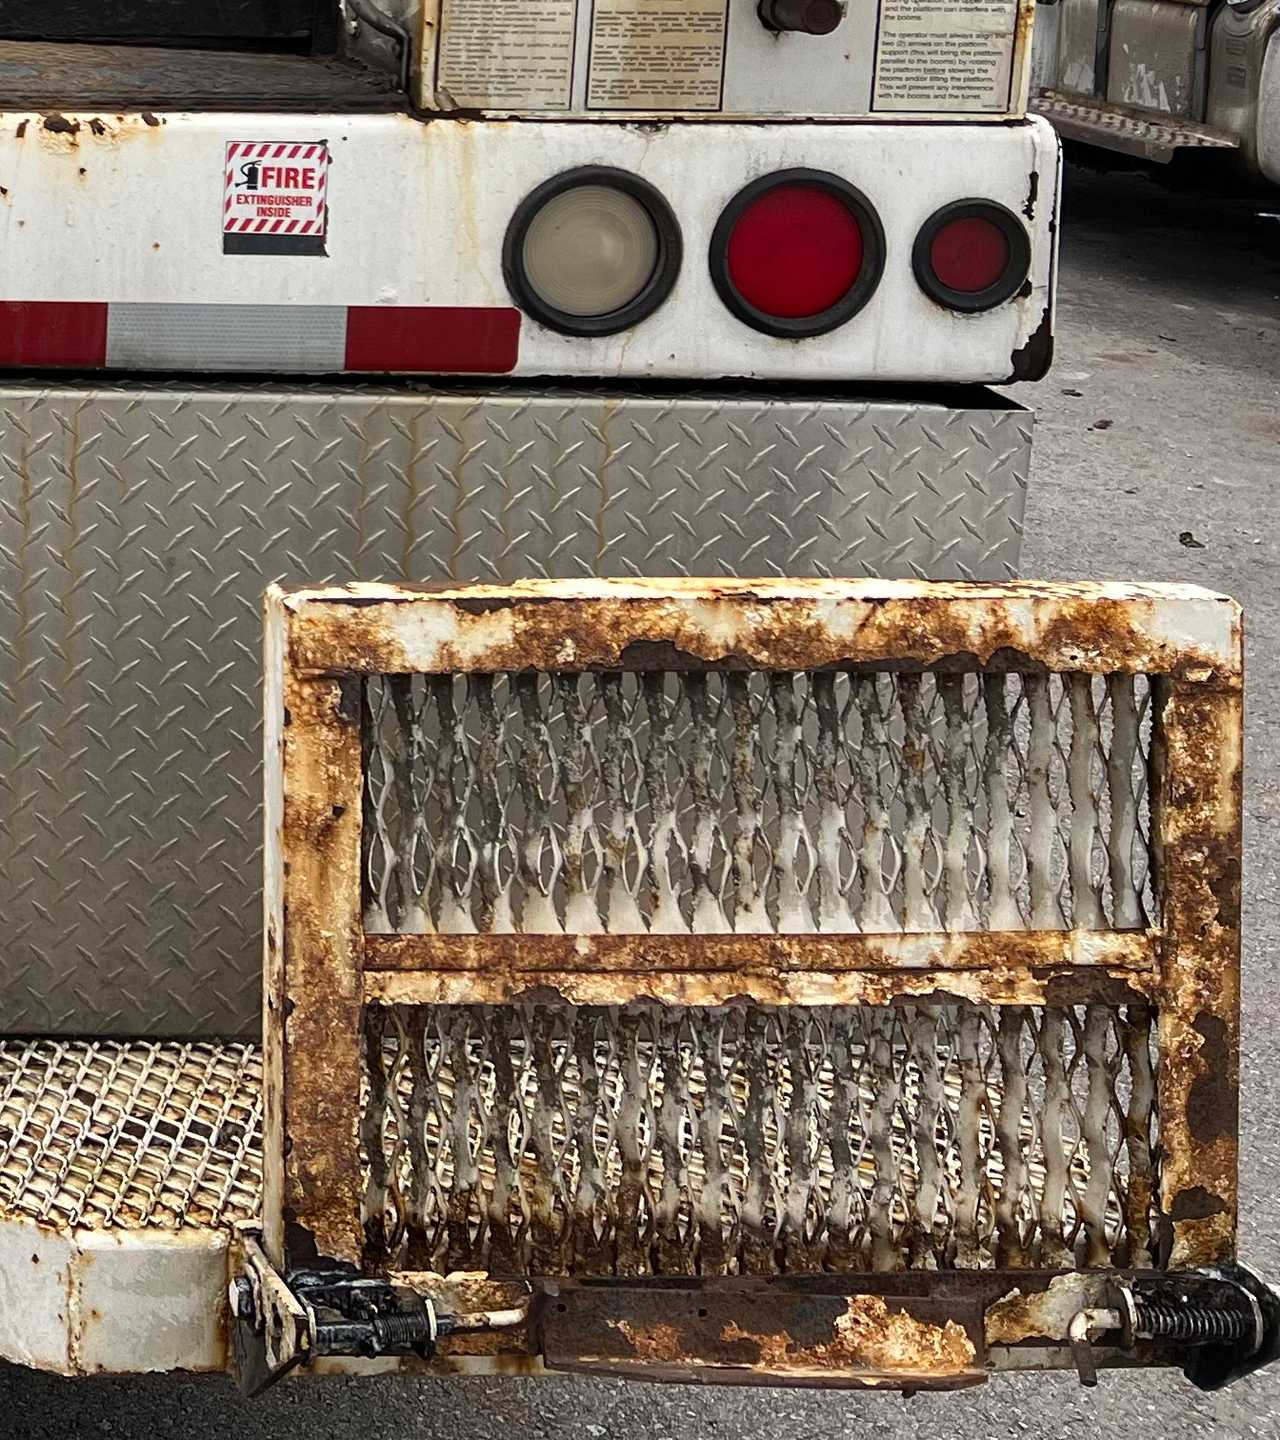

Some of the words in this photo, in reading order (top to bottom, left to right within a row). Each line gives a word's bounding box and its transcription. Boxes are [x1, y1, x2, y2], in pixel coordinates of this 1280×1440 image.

[261, 167, 316, 189] FIRE
[236, 194, 313, 206] EXTINGUISHER
[257, 207, 291, 217] INSIDE
